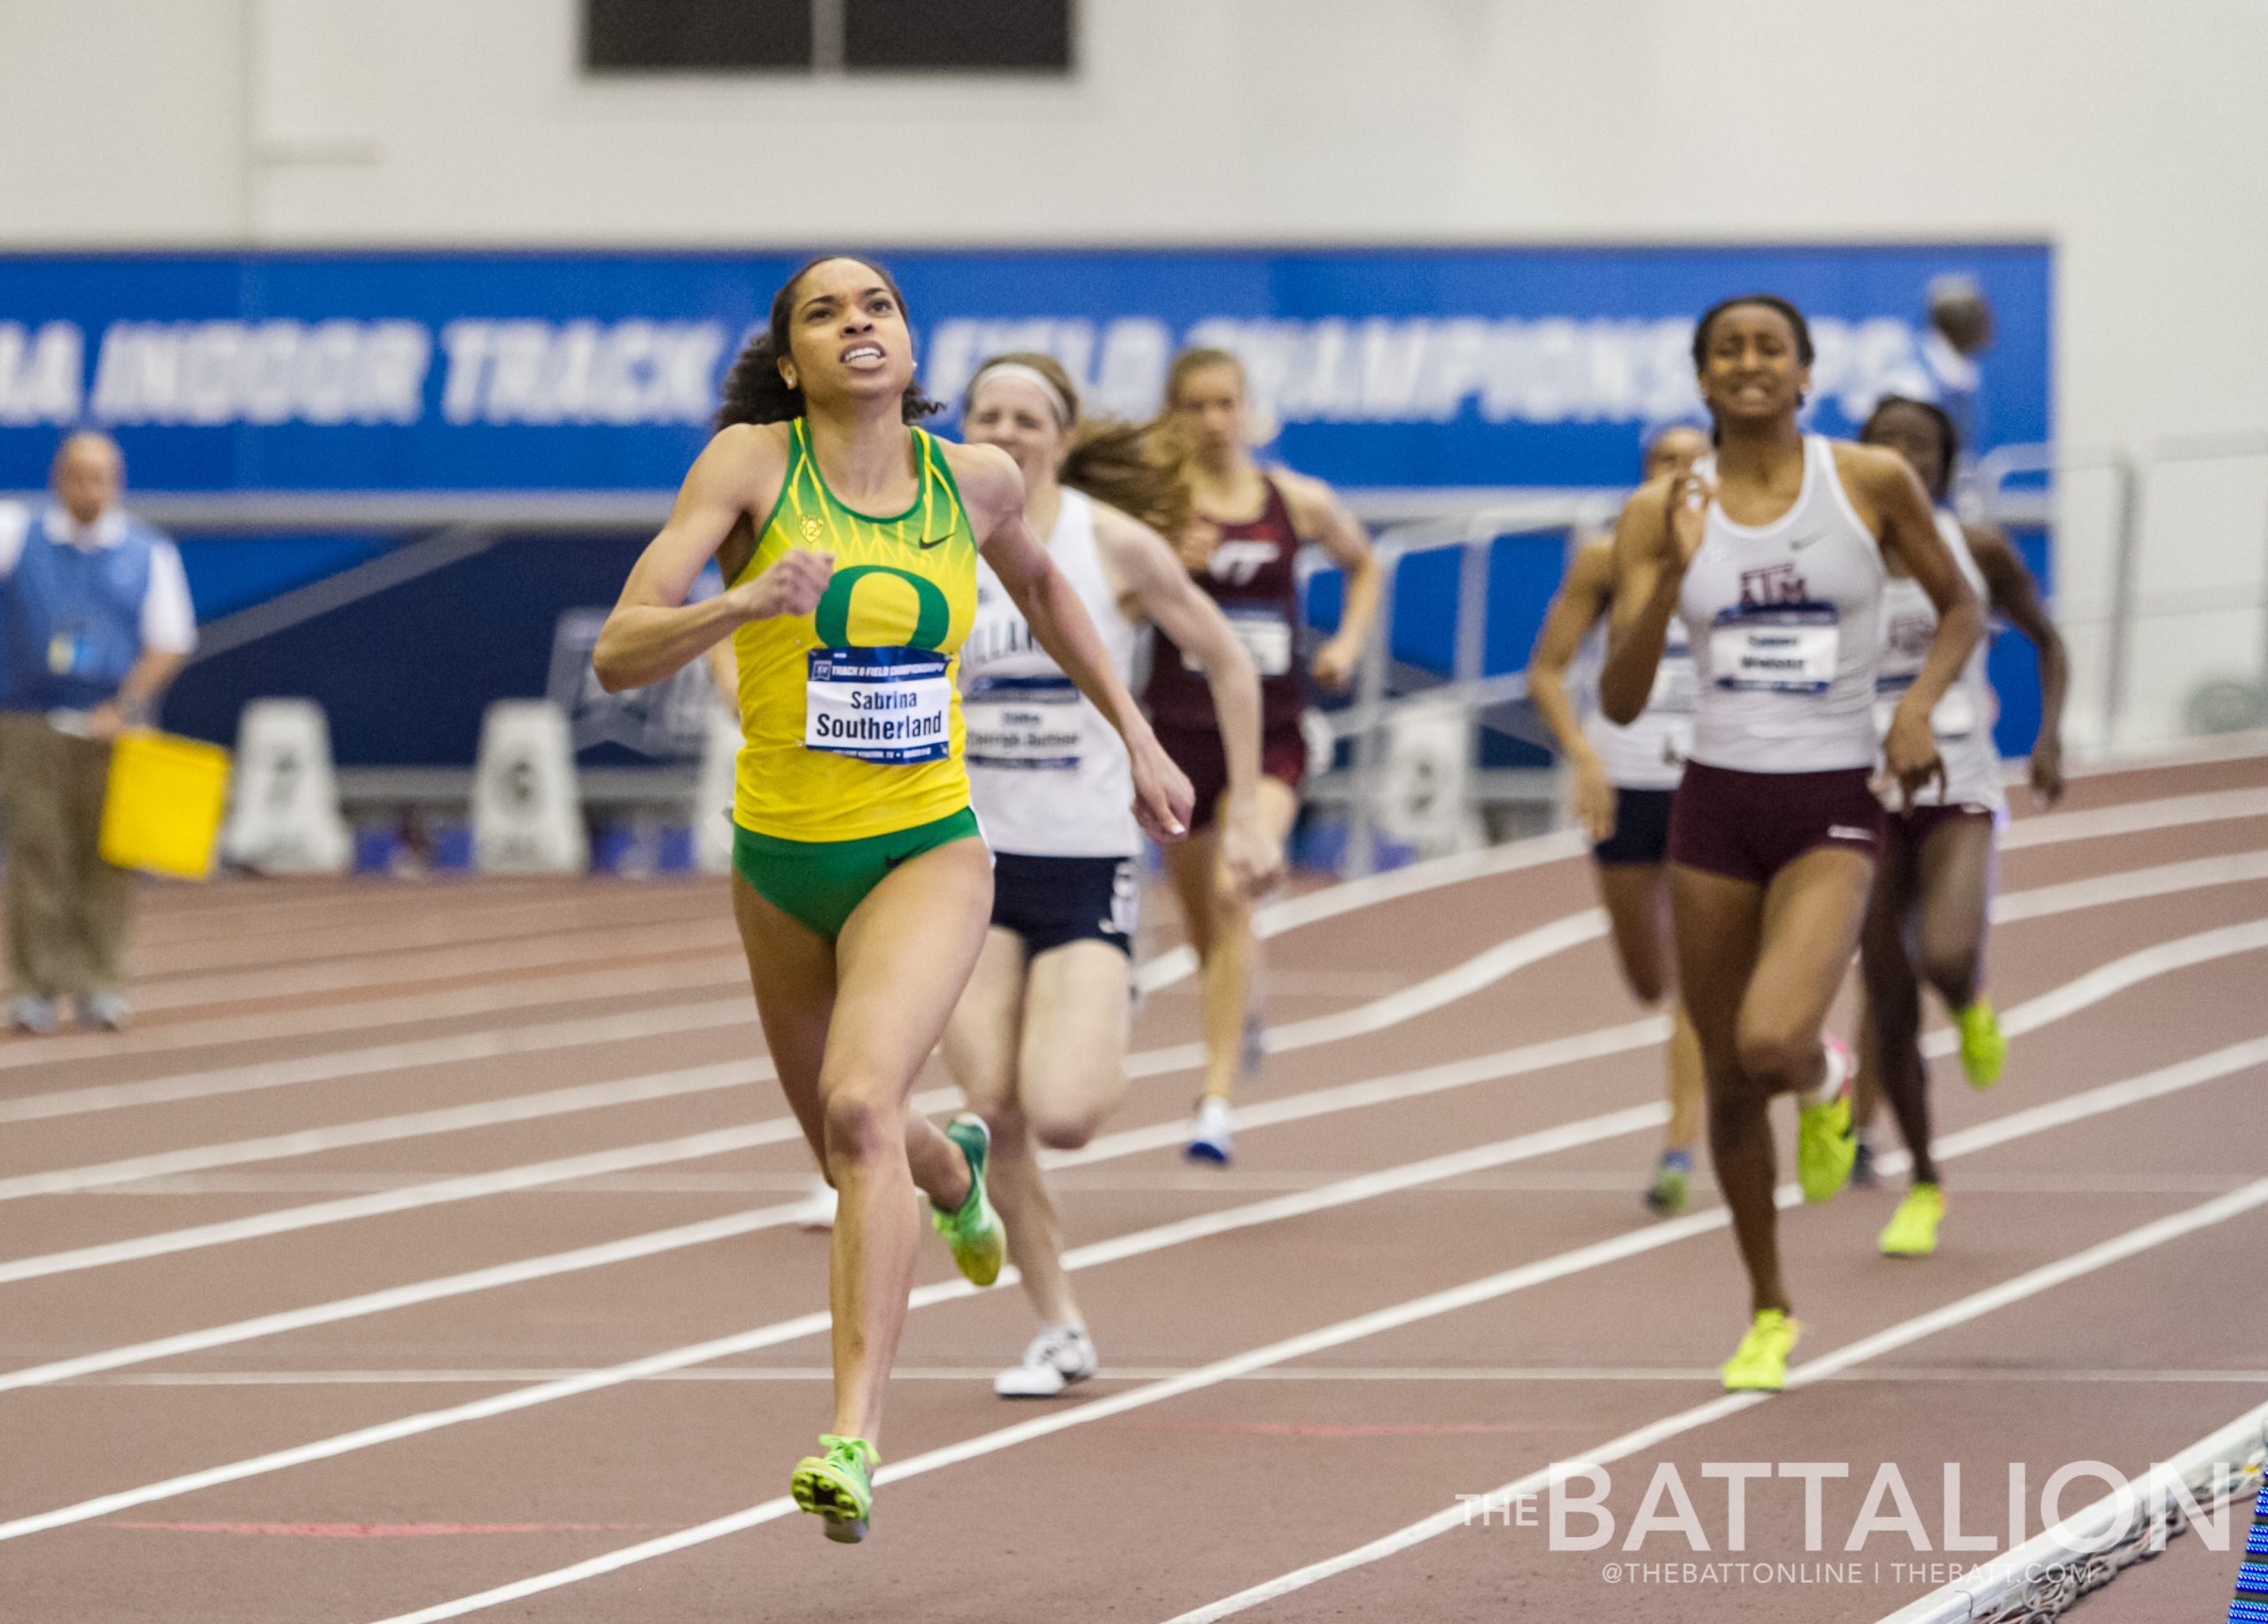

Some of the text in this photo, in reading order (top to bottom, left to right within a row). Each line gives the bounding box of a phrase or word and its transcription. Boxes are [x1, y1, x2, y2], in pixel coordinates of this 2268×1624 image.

[442, 318, 719, 426] TRACK
[850, 690, 918, 710] Sabrina
[816, 710, 943, 740] Southerland
